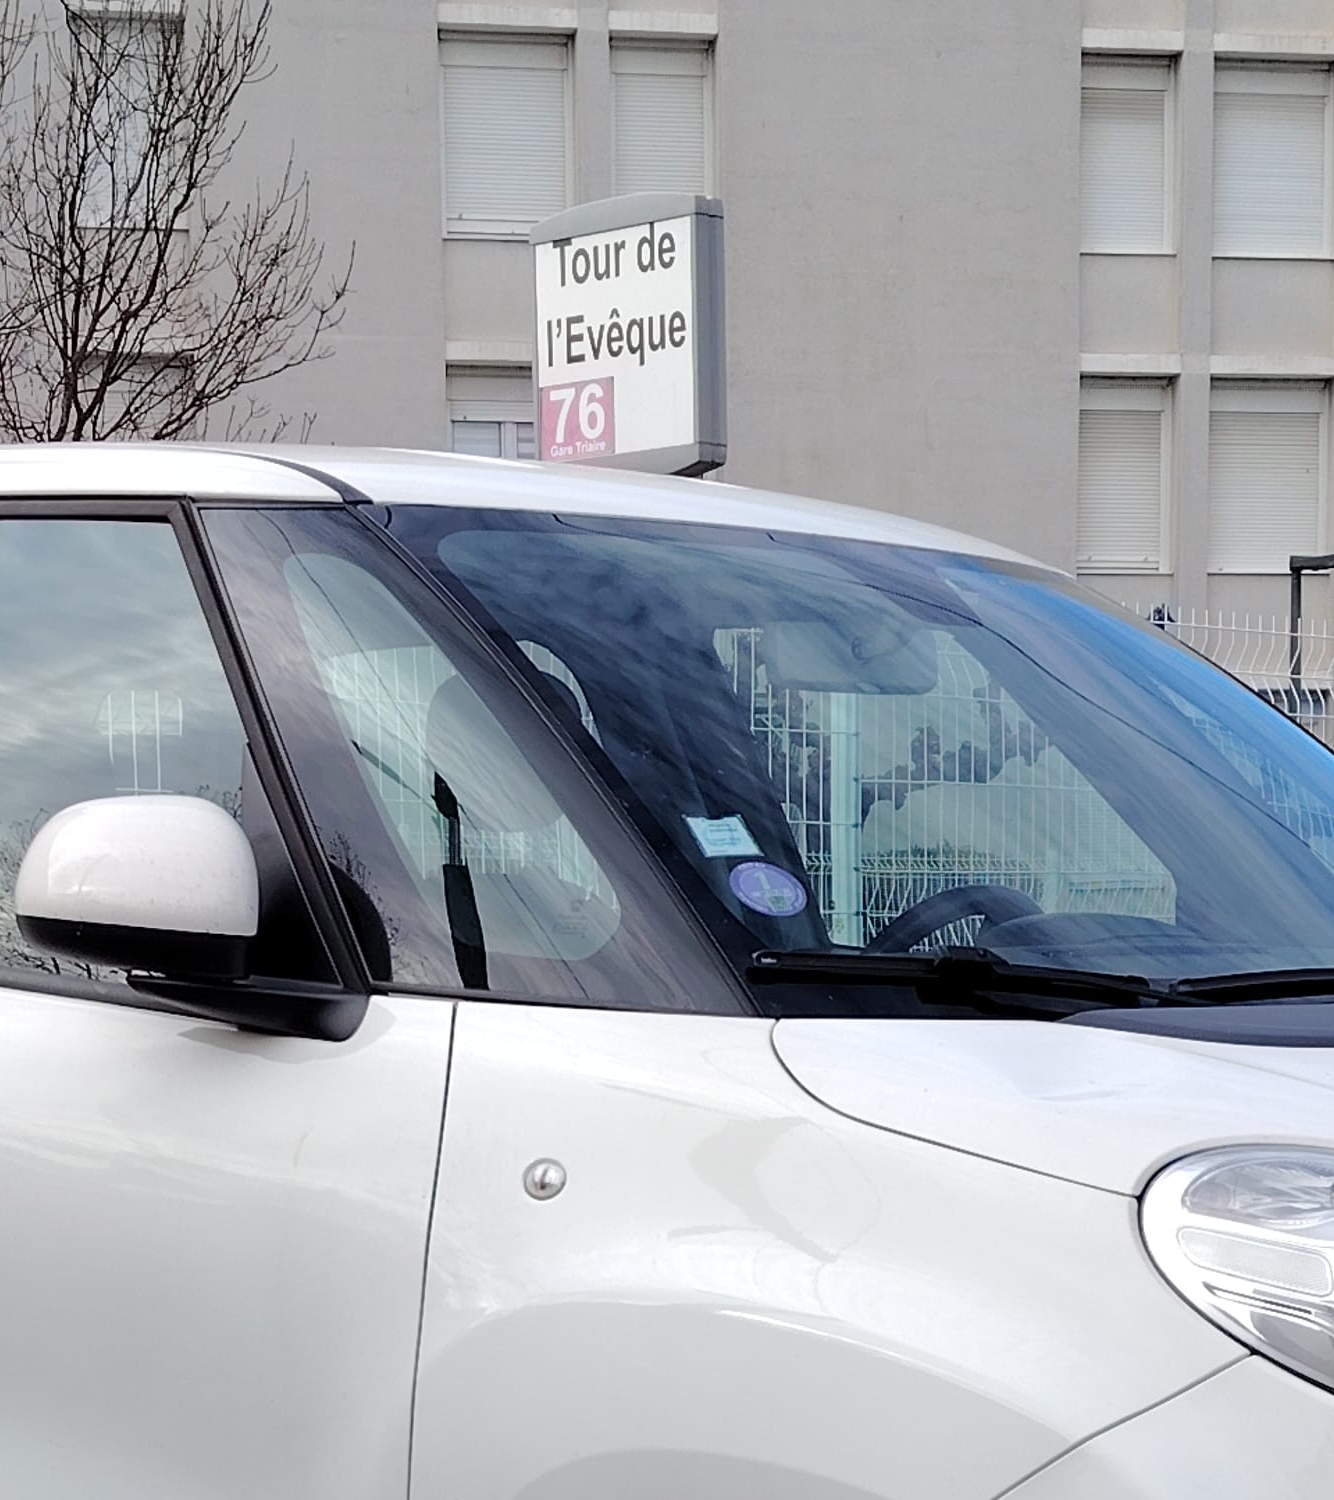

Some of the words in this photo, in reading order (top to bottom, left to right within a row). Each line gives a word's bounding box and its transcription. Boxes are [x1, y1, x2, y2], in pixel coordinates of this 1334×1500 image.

[552, 237, 626, 287] Tour
[636, 221, 676, 273] de
[546, 307, 687, 368] l'Evêque
[548, 382, 605, 444] 76
